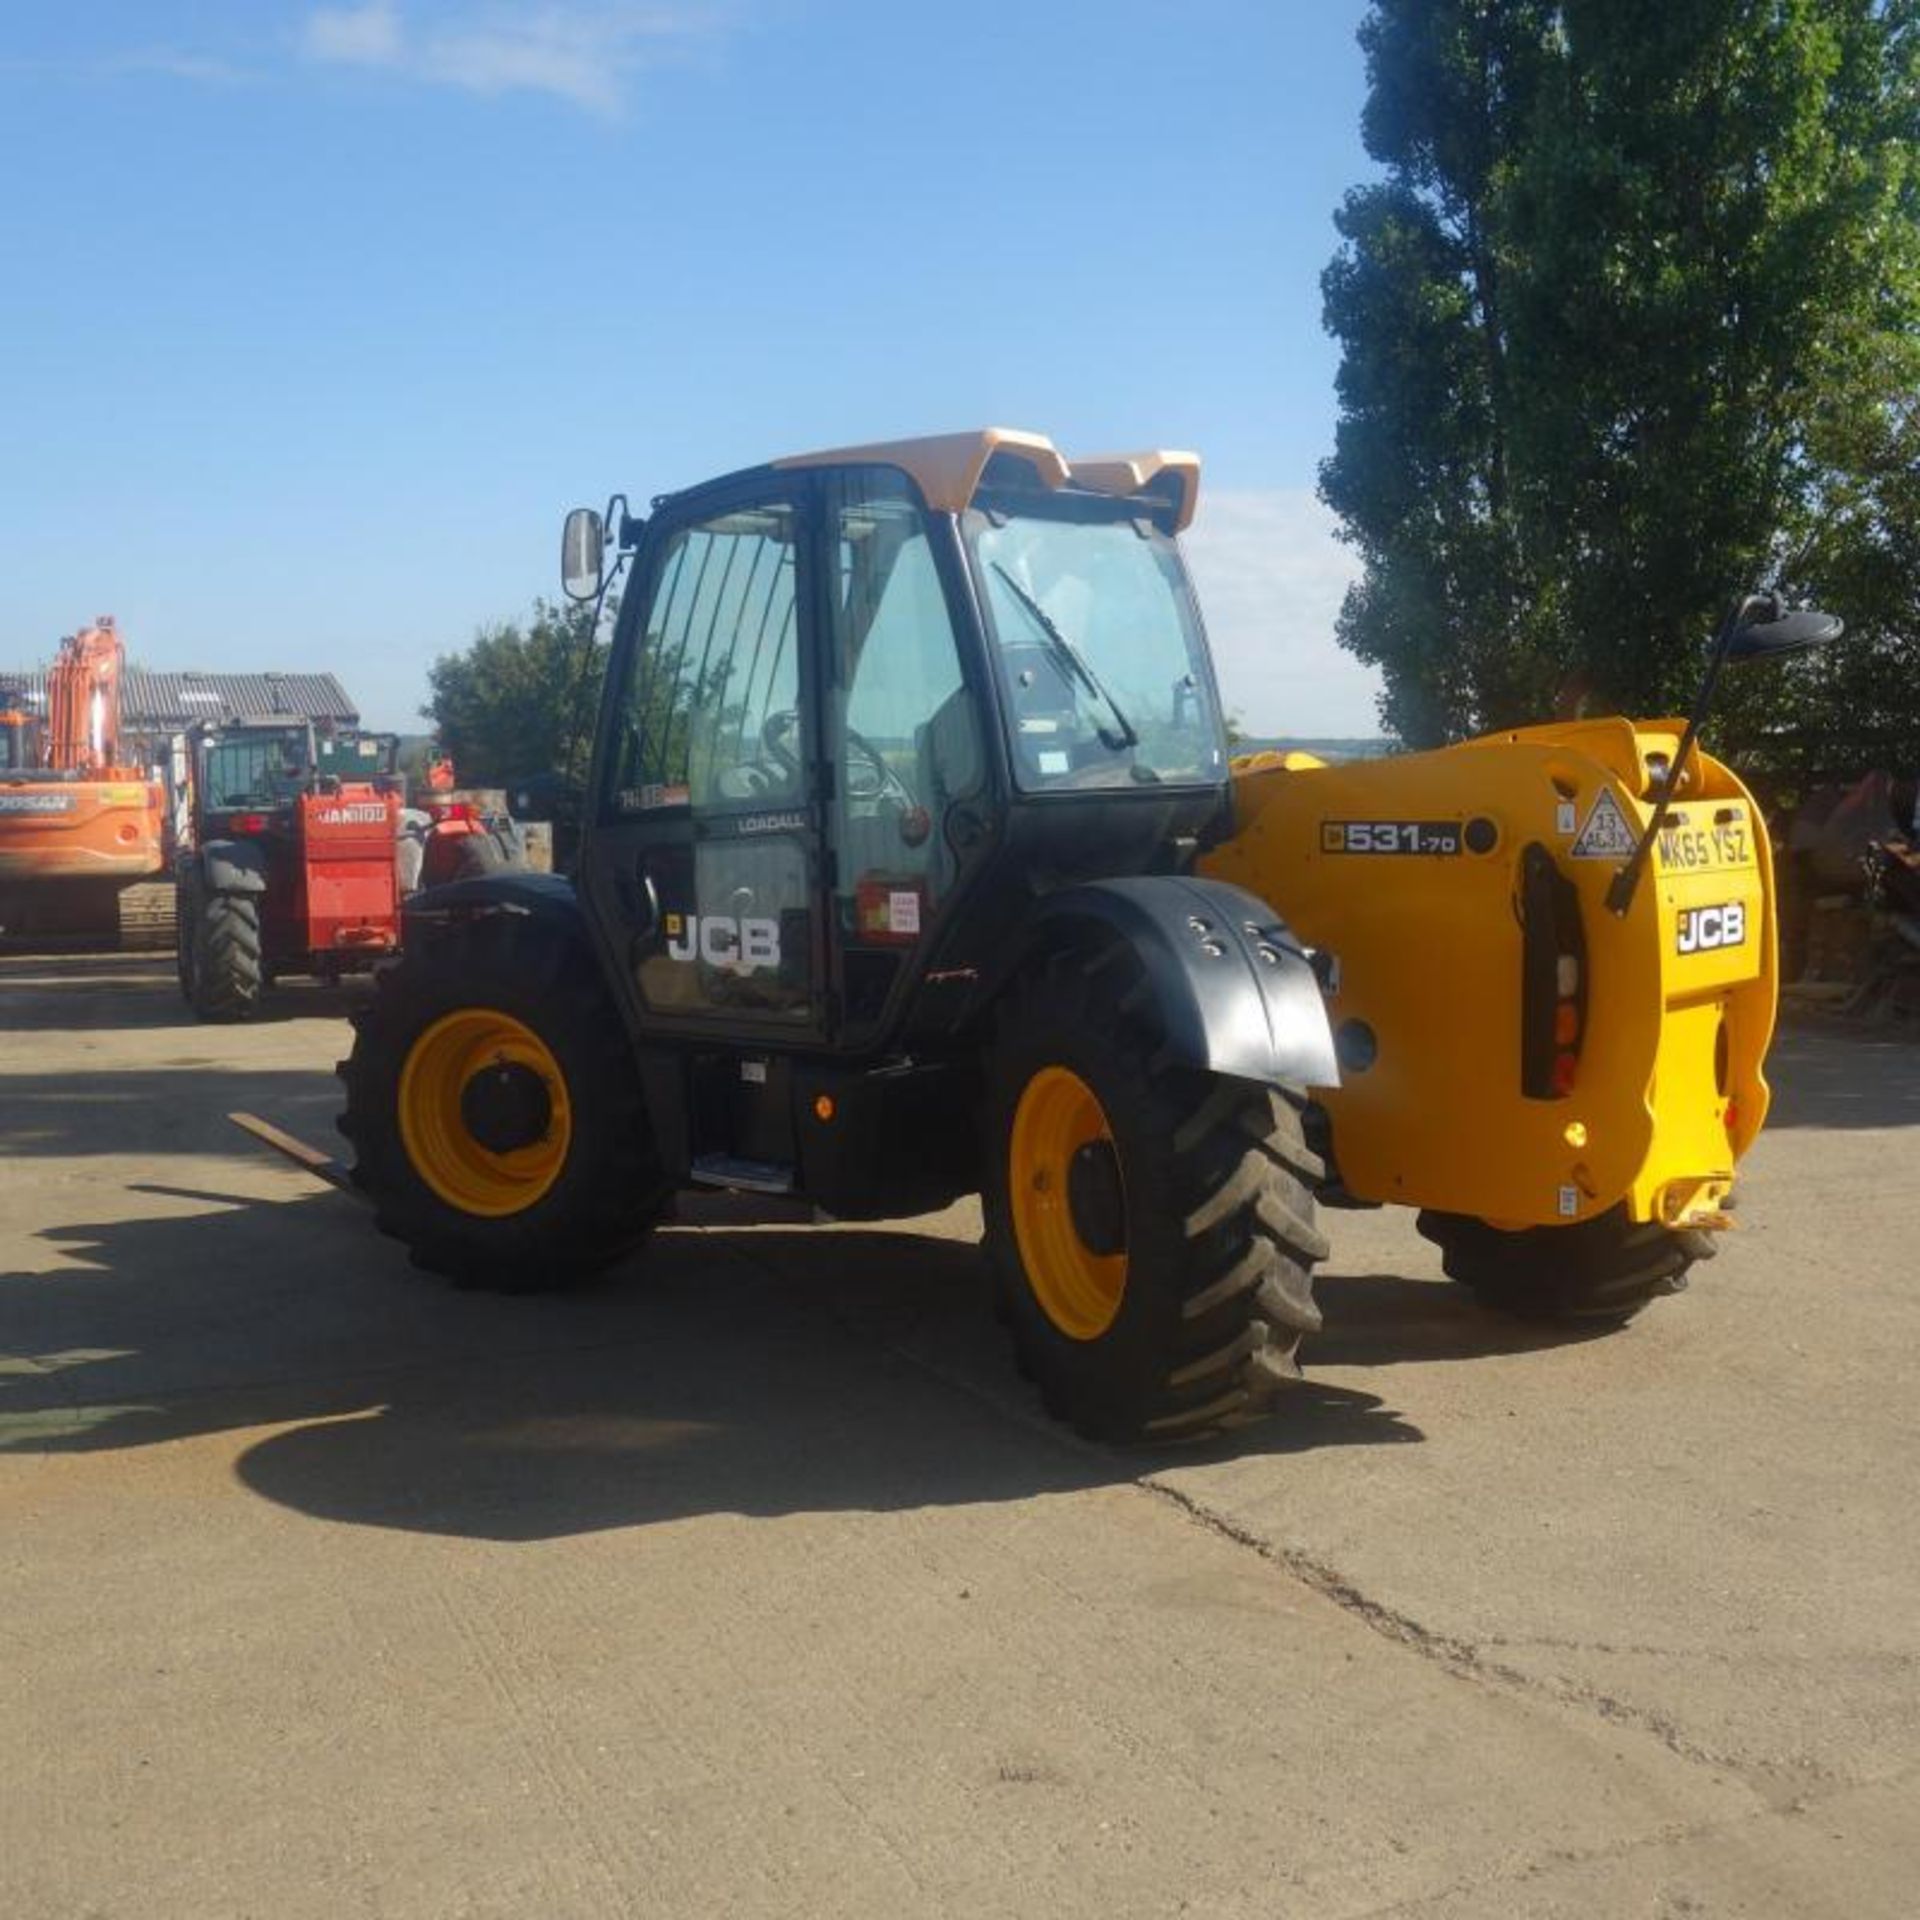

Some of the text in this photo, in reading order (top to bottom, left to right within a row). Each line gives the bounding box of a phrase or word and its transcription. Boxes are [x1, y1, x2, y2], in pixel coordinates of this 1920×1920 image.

[739, 814, 804, 832] LOADALL
[1658, 828, 1749, 869] MK65 YSZ
[667, 914, 781, 967] JCB
[1678, 906, 1744, 952] JCB
